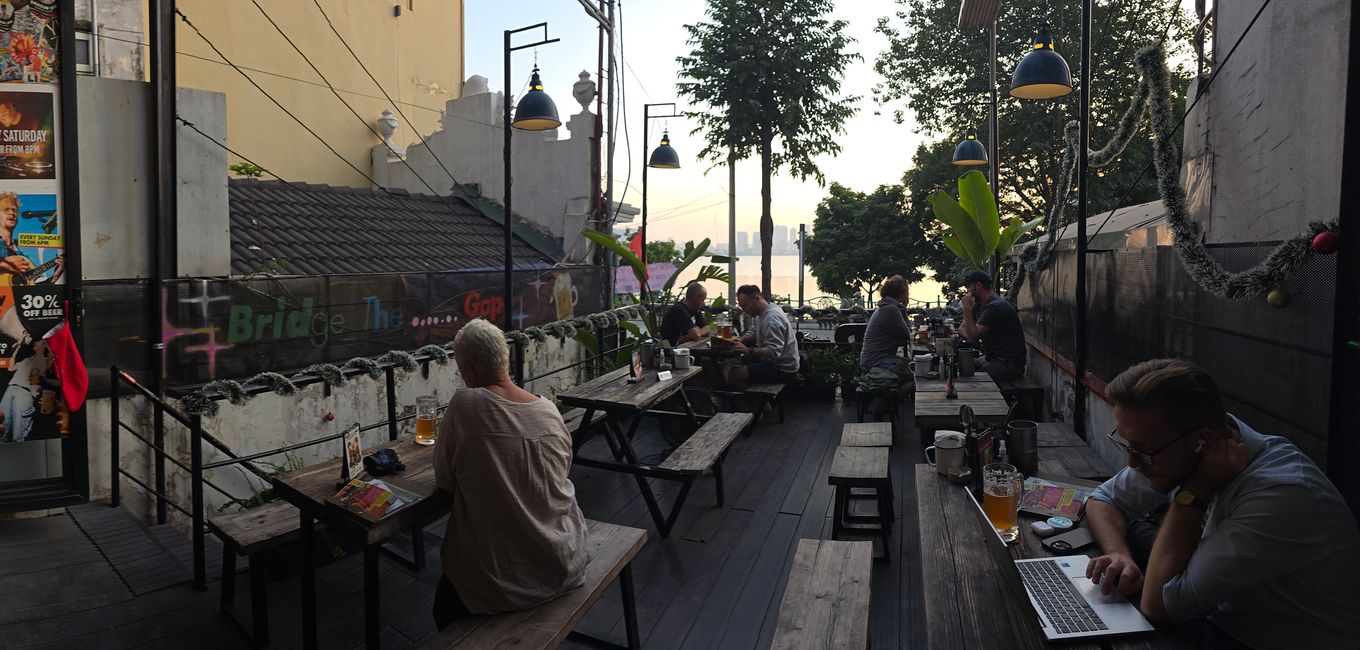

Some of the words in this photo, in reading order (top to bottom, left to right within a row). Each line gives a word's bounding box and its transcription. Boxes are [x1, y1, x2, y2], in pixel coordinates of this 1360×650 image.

[3, 129, 48, 142] SATURDAY
[5, 144, 24, 154] FROM
[25, 144, 40, 154] 8PM
[21, 294, 61, 310] 30%
[42, 308, 63, 316] BEER
[227, 297, 345, 349] Bridge
[361, 296, 403, 336] The
[463, 290, 504, 324] Gap
